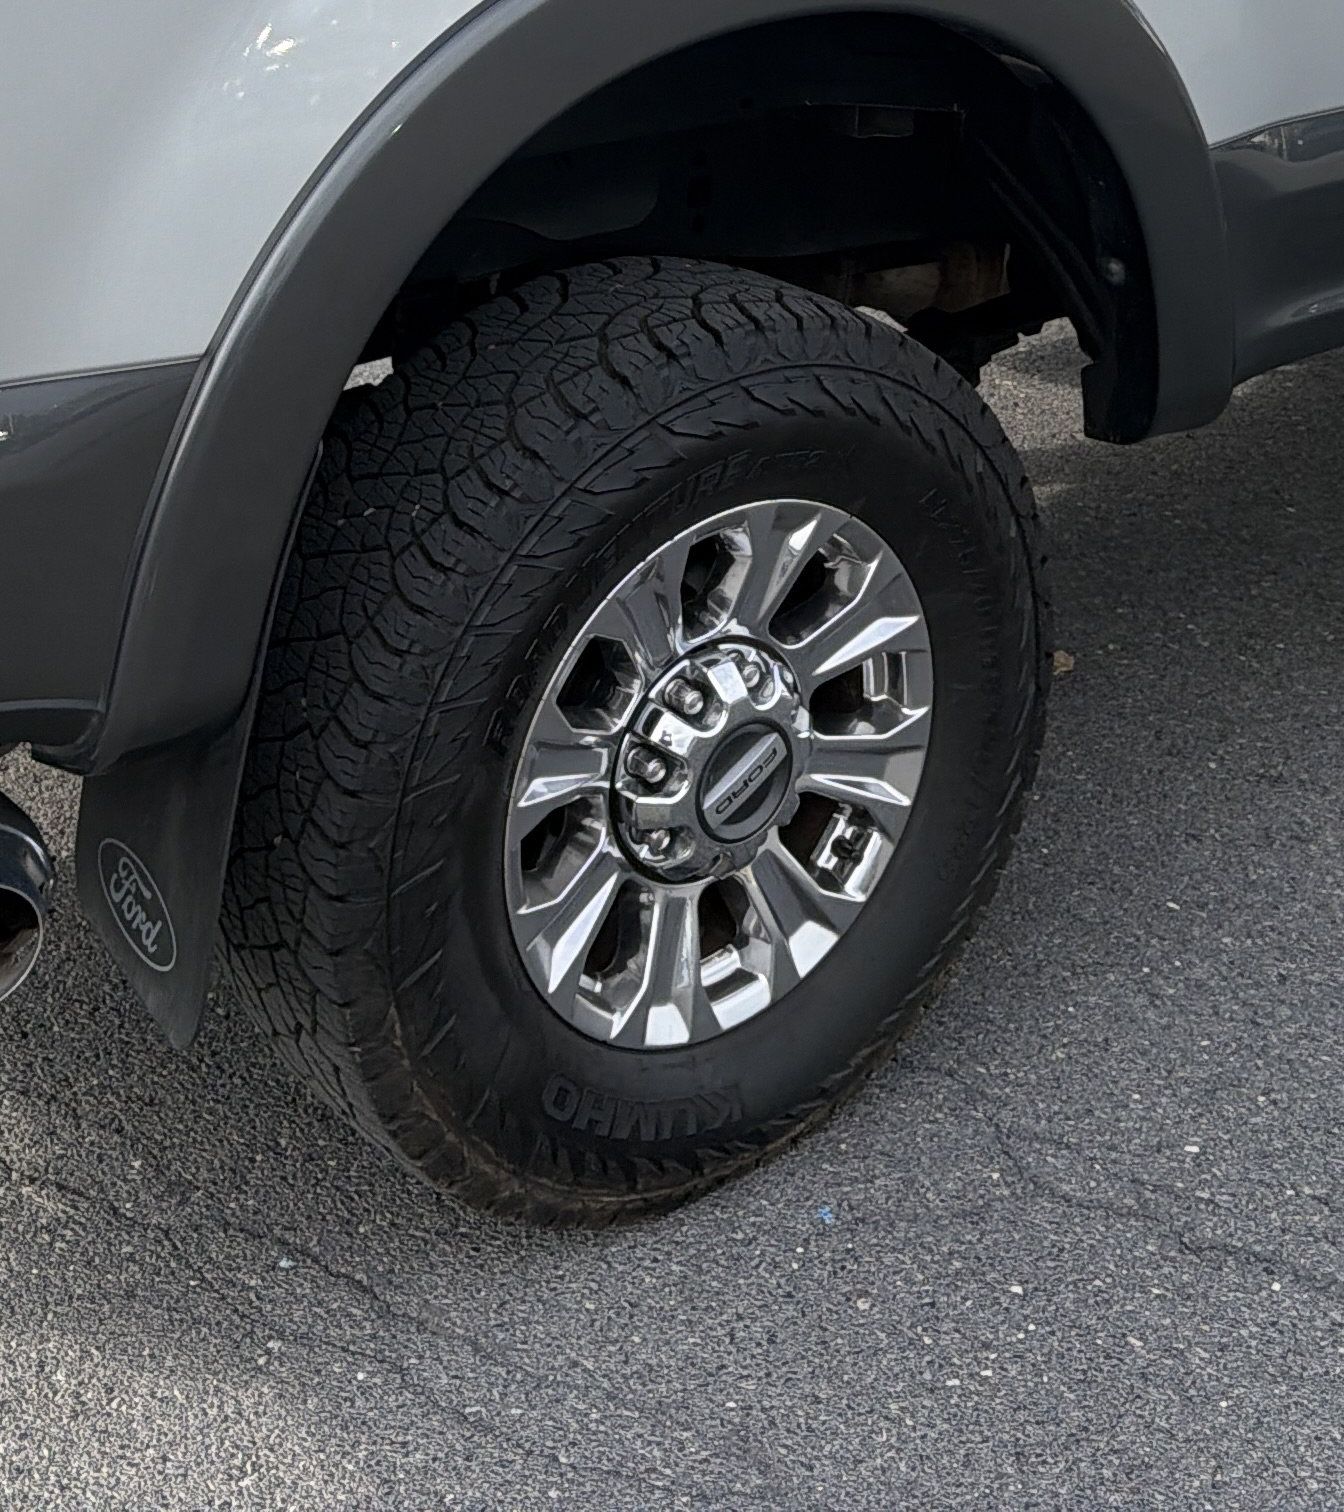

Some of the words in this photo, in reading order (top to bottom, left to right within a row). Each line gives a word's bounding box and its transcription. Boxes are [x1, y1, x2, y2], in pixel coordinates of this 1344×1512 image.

[715, 747, 778, 815] FORD
[109, 856, 162, 954] Ford
[542, 1073, 742, 1141] KUMHO
